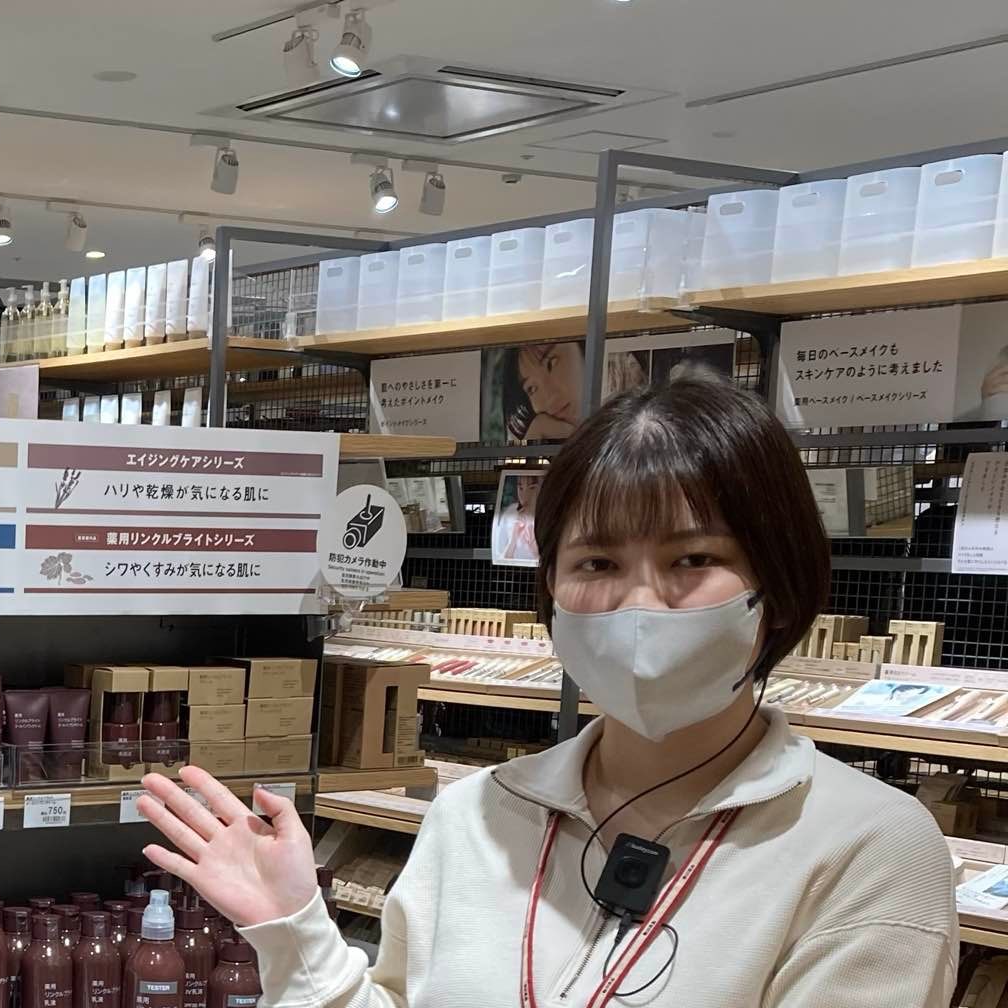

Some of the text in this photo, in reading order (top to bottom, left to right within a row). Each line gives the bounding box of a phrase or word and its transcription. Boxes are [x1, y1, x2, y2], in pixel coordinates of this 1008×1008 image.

[797, 343, 899, 362] 毎日のベースメイクも
[795, 360, 943, 381] スキンケアのように考えました
[126, 453, 245, 469] エイジングケアシリーズ
[104, 483, 270, 502] ハリや乾燥が気になる肌に
[105, 532, 256, 546] 薬用リンクルブライトシリーズ
[328, 552, 387, 569] 防犯カメラ作動中
[105, 561, 261, 579] シワやくすみが気になる肌に
[44, 999, 57, 1007] 乳液
